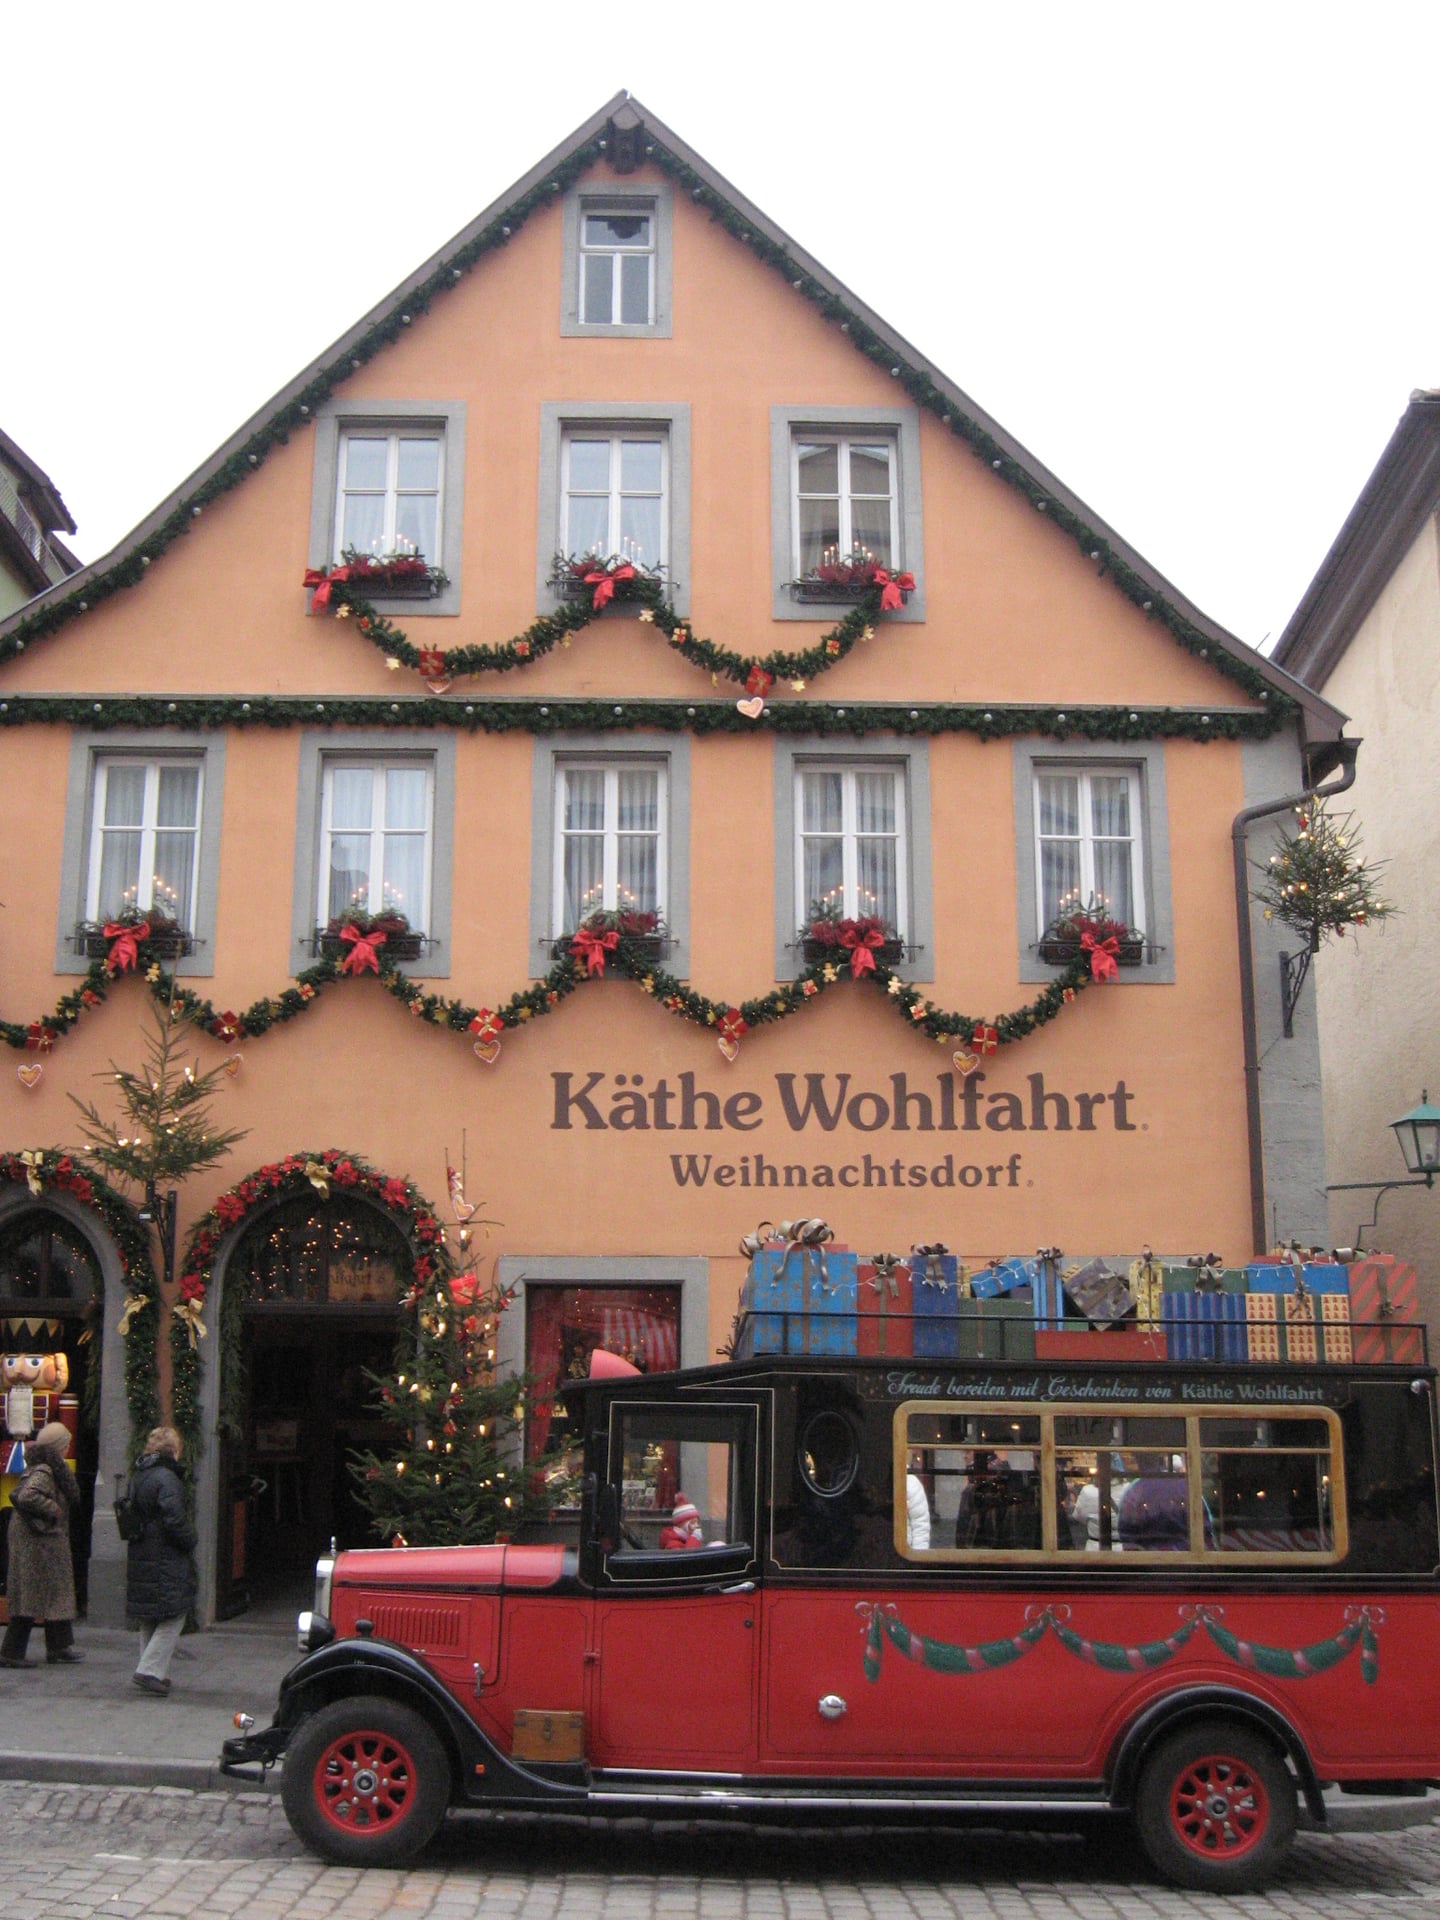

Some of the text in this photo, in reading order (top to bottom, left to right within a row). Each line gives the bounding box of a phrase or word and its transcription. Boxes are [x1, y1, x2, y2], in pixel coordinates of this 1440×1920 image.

[550, 1071, 1137, 1131] Käthe Wohlfahrt
[670, 1153, 1022, 1188] Weihnachtsdorf
[886, 1371, 1324, 1402] Freude bereiten mit Geschenken von Käthe Wohlfahrt
